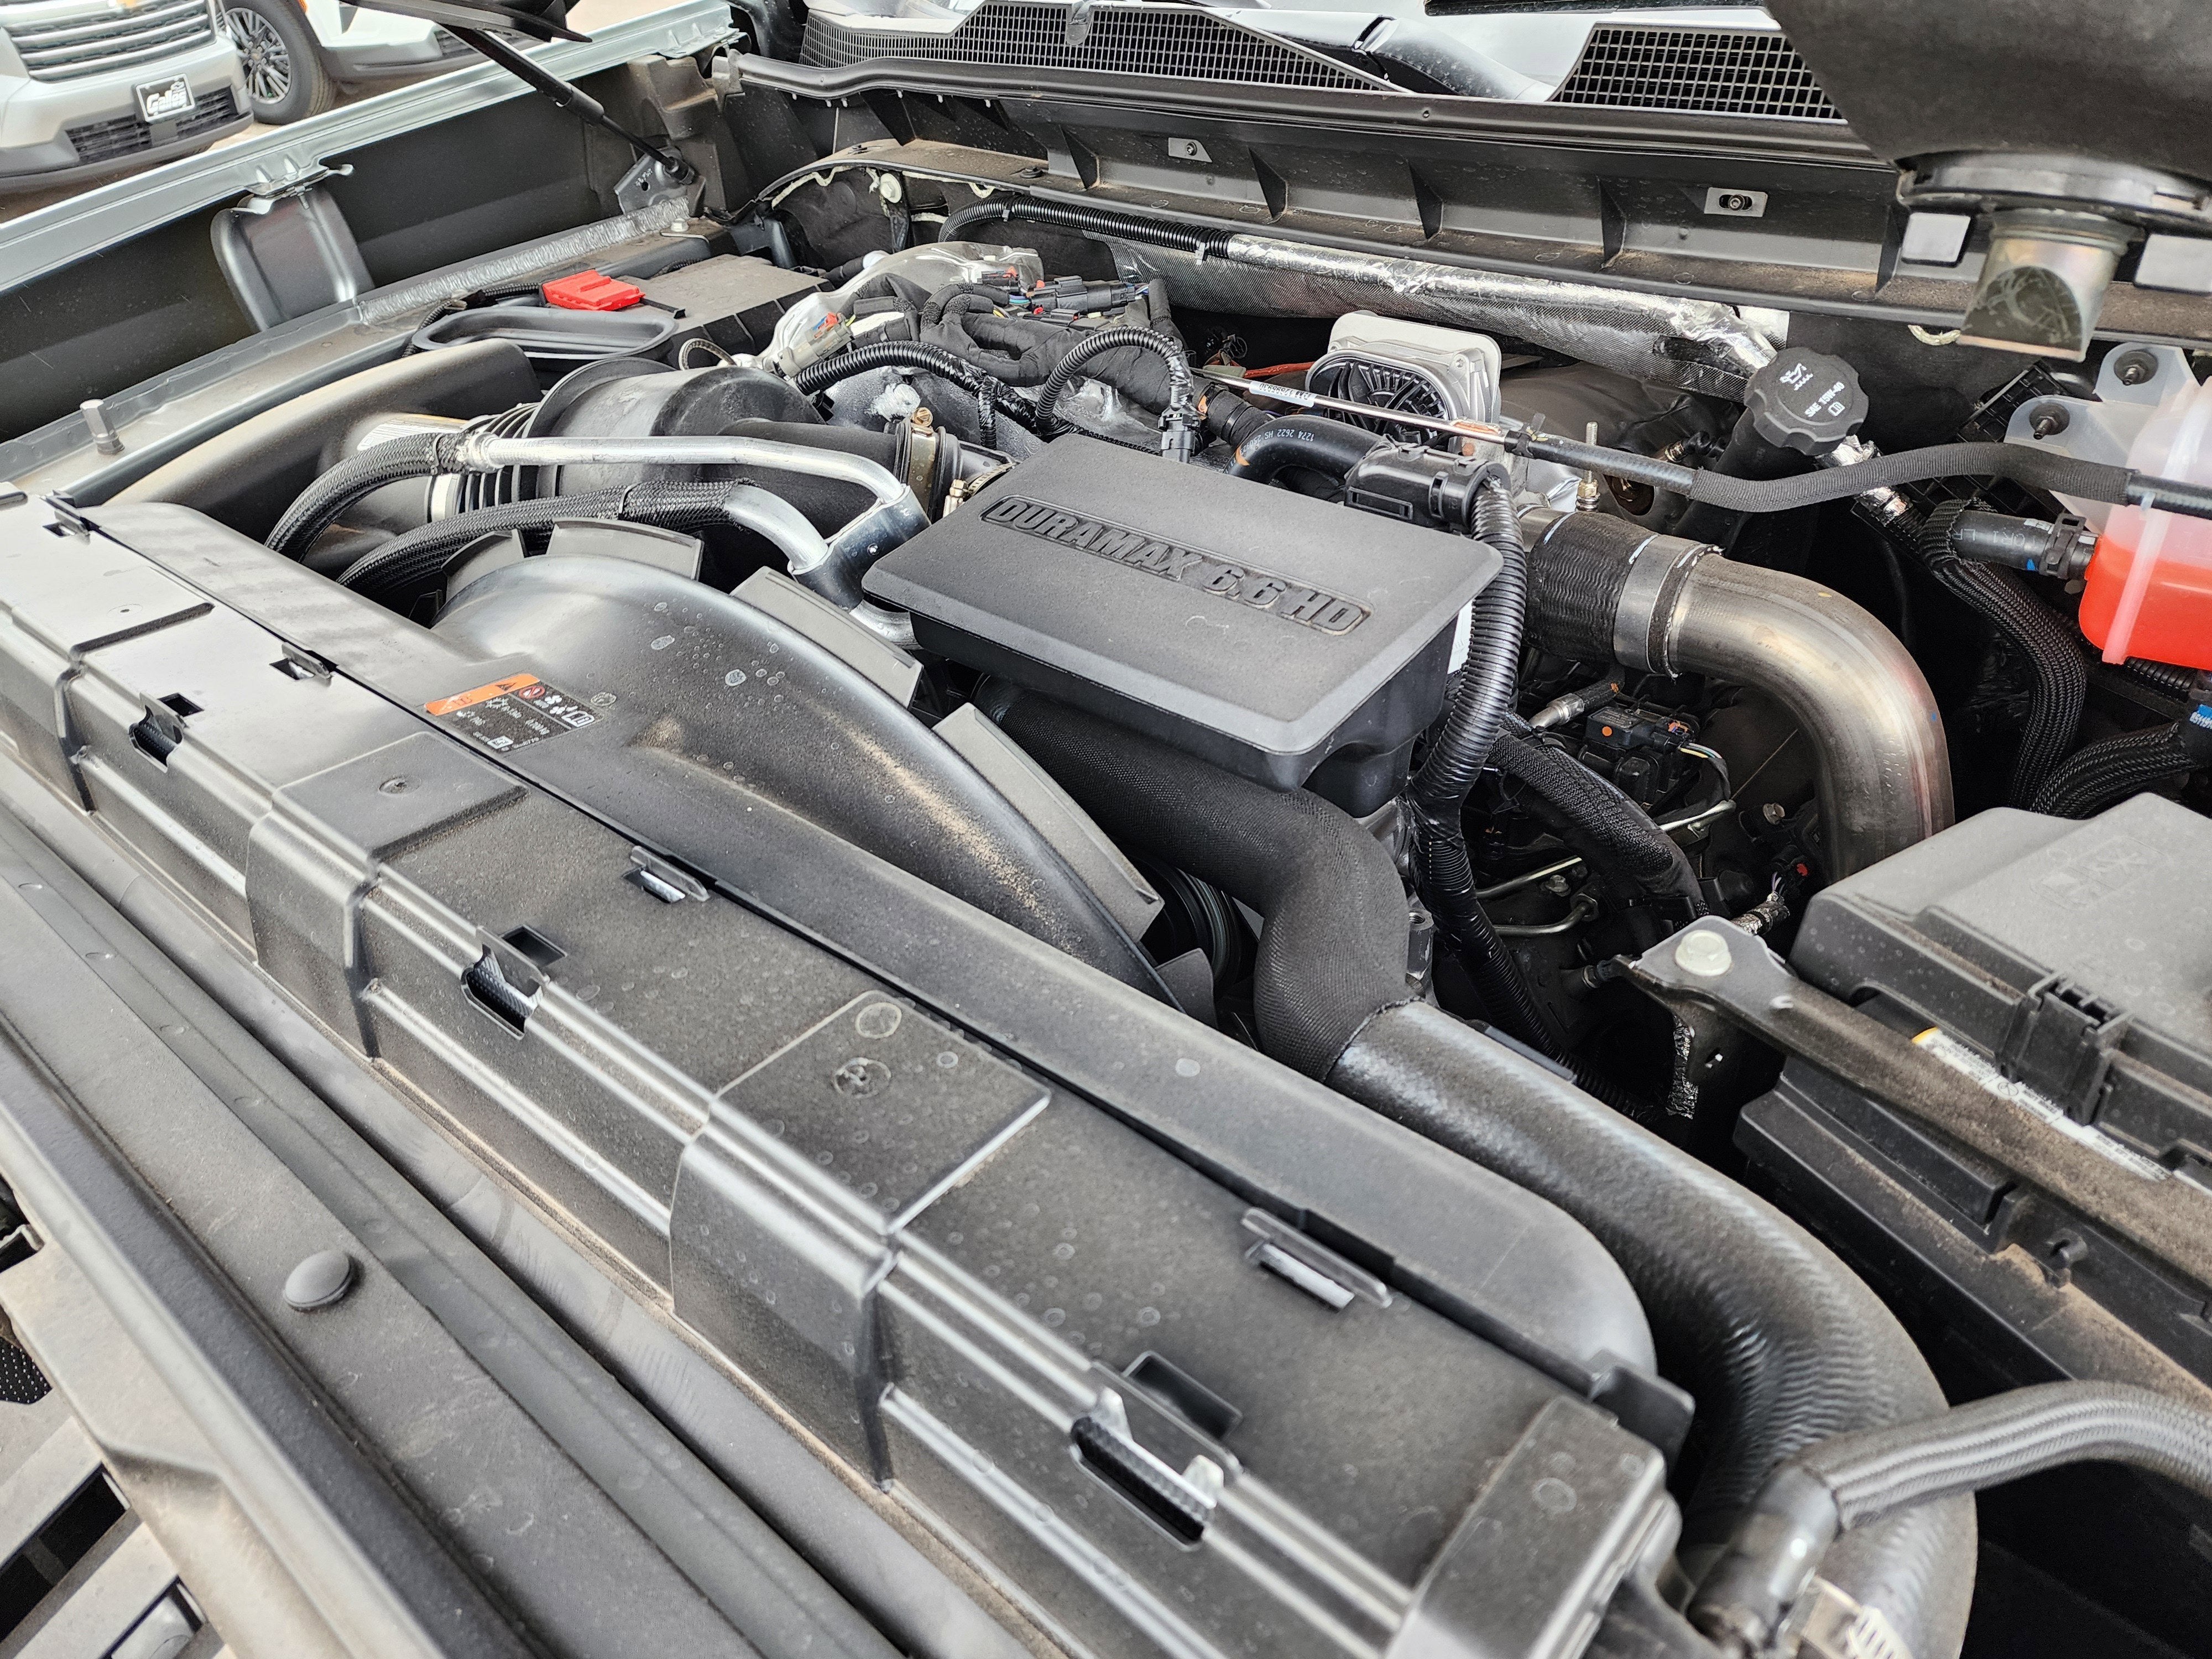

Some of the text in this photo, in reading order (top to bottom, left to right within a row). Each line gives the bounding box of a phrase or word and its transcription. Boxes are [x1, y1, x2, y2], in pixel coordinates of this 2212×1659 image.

[1804, 381, 1845, 418] SAE 15W-40
[1264, 430, 1274, 440] HS
[1277, 429, 1295, 437] 2622
[1297, 430, 1314, 442] 1274
[992, 497, 1367, 634] DURAMAX 6.6 HD
